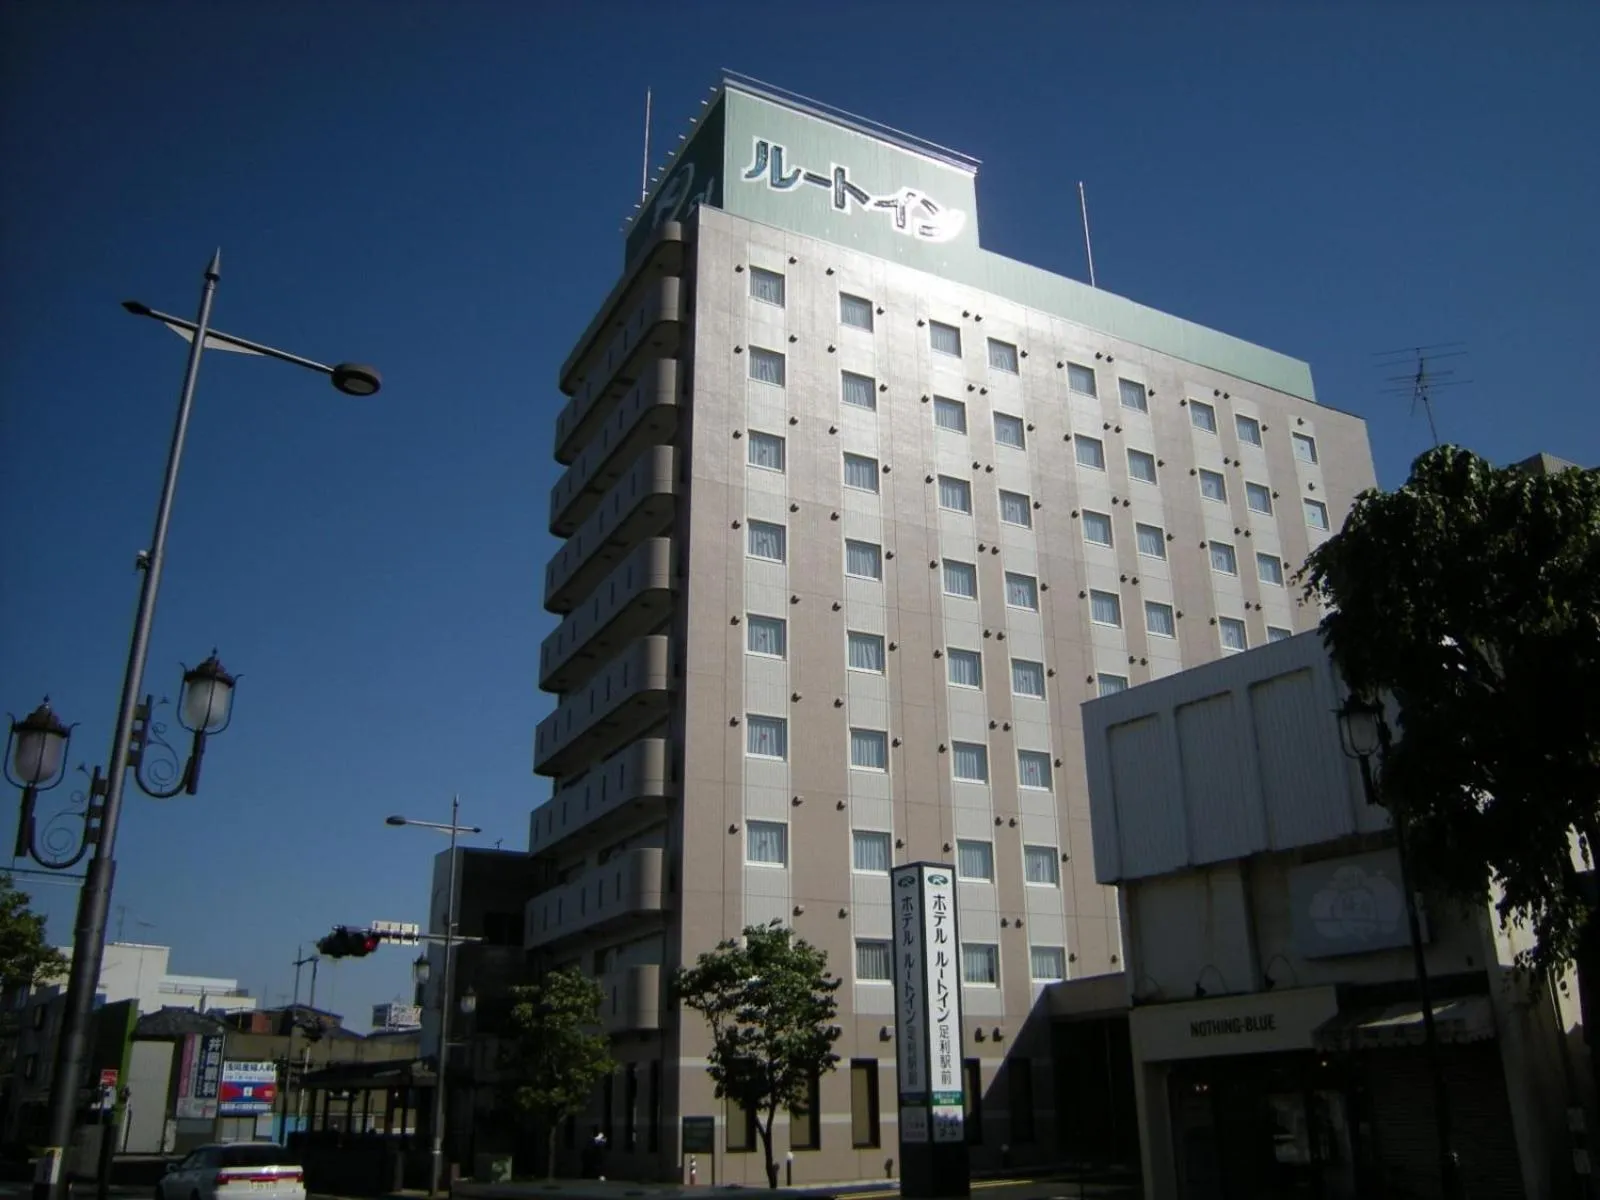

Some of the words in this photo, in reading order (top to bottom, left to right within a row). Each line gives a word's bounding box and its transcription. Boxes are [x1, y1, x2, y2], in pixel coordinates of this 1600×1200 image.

[742, 137, 964, 242] ルートイン
